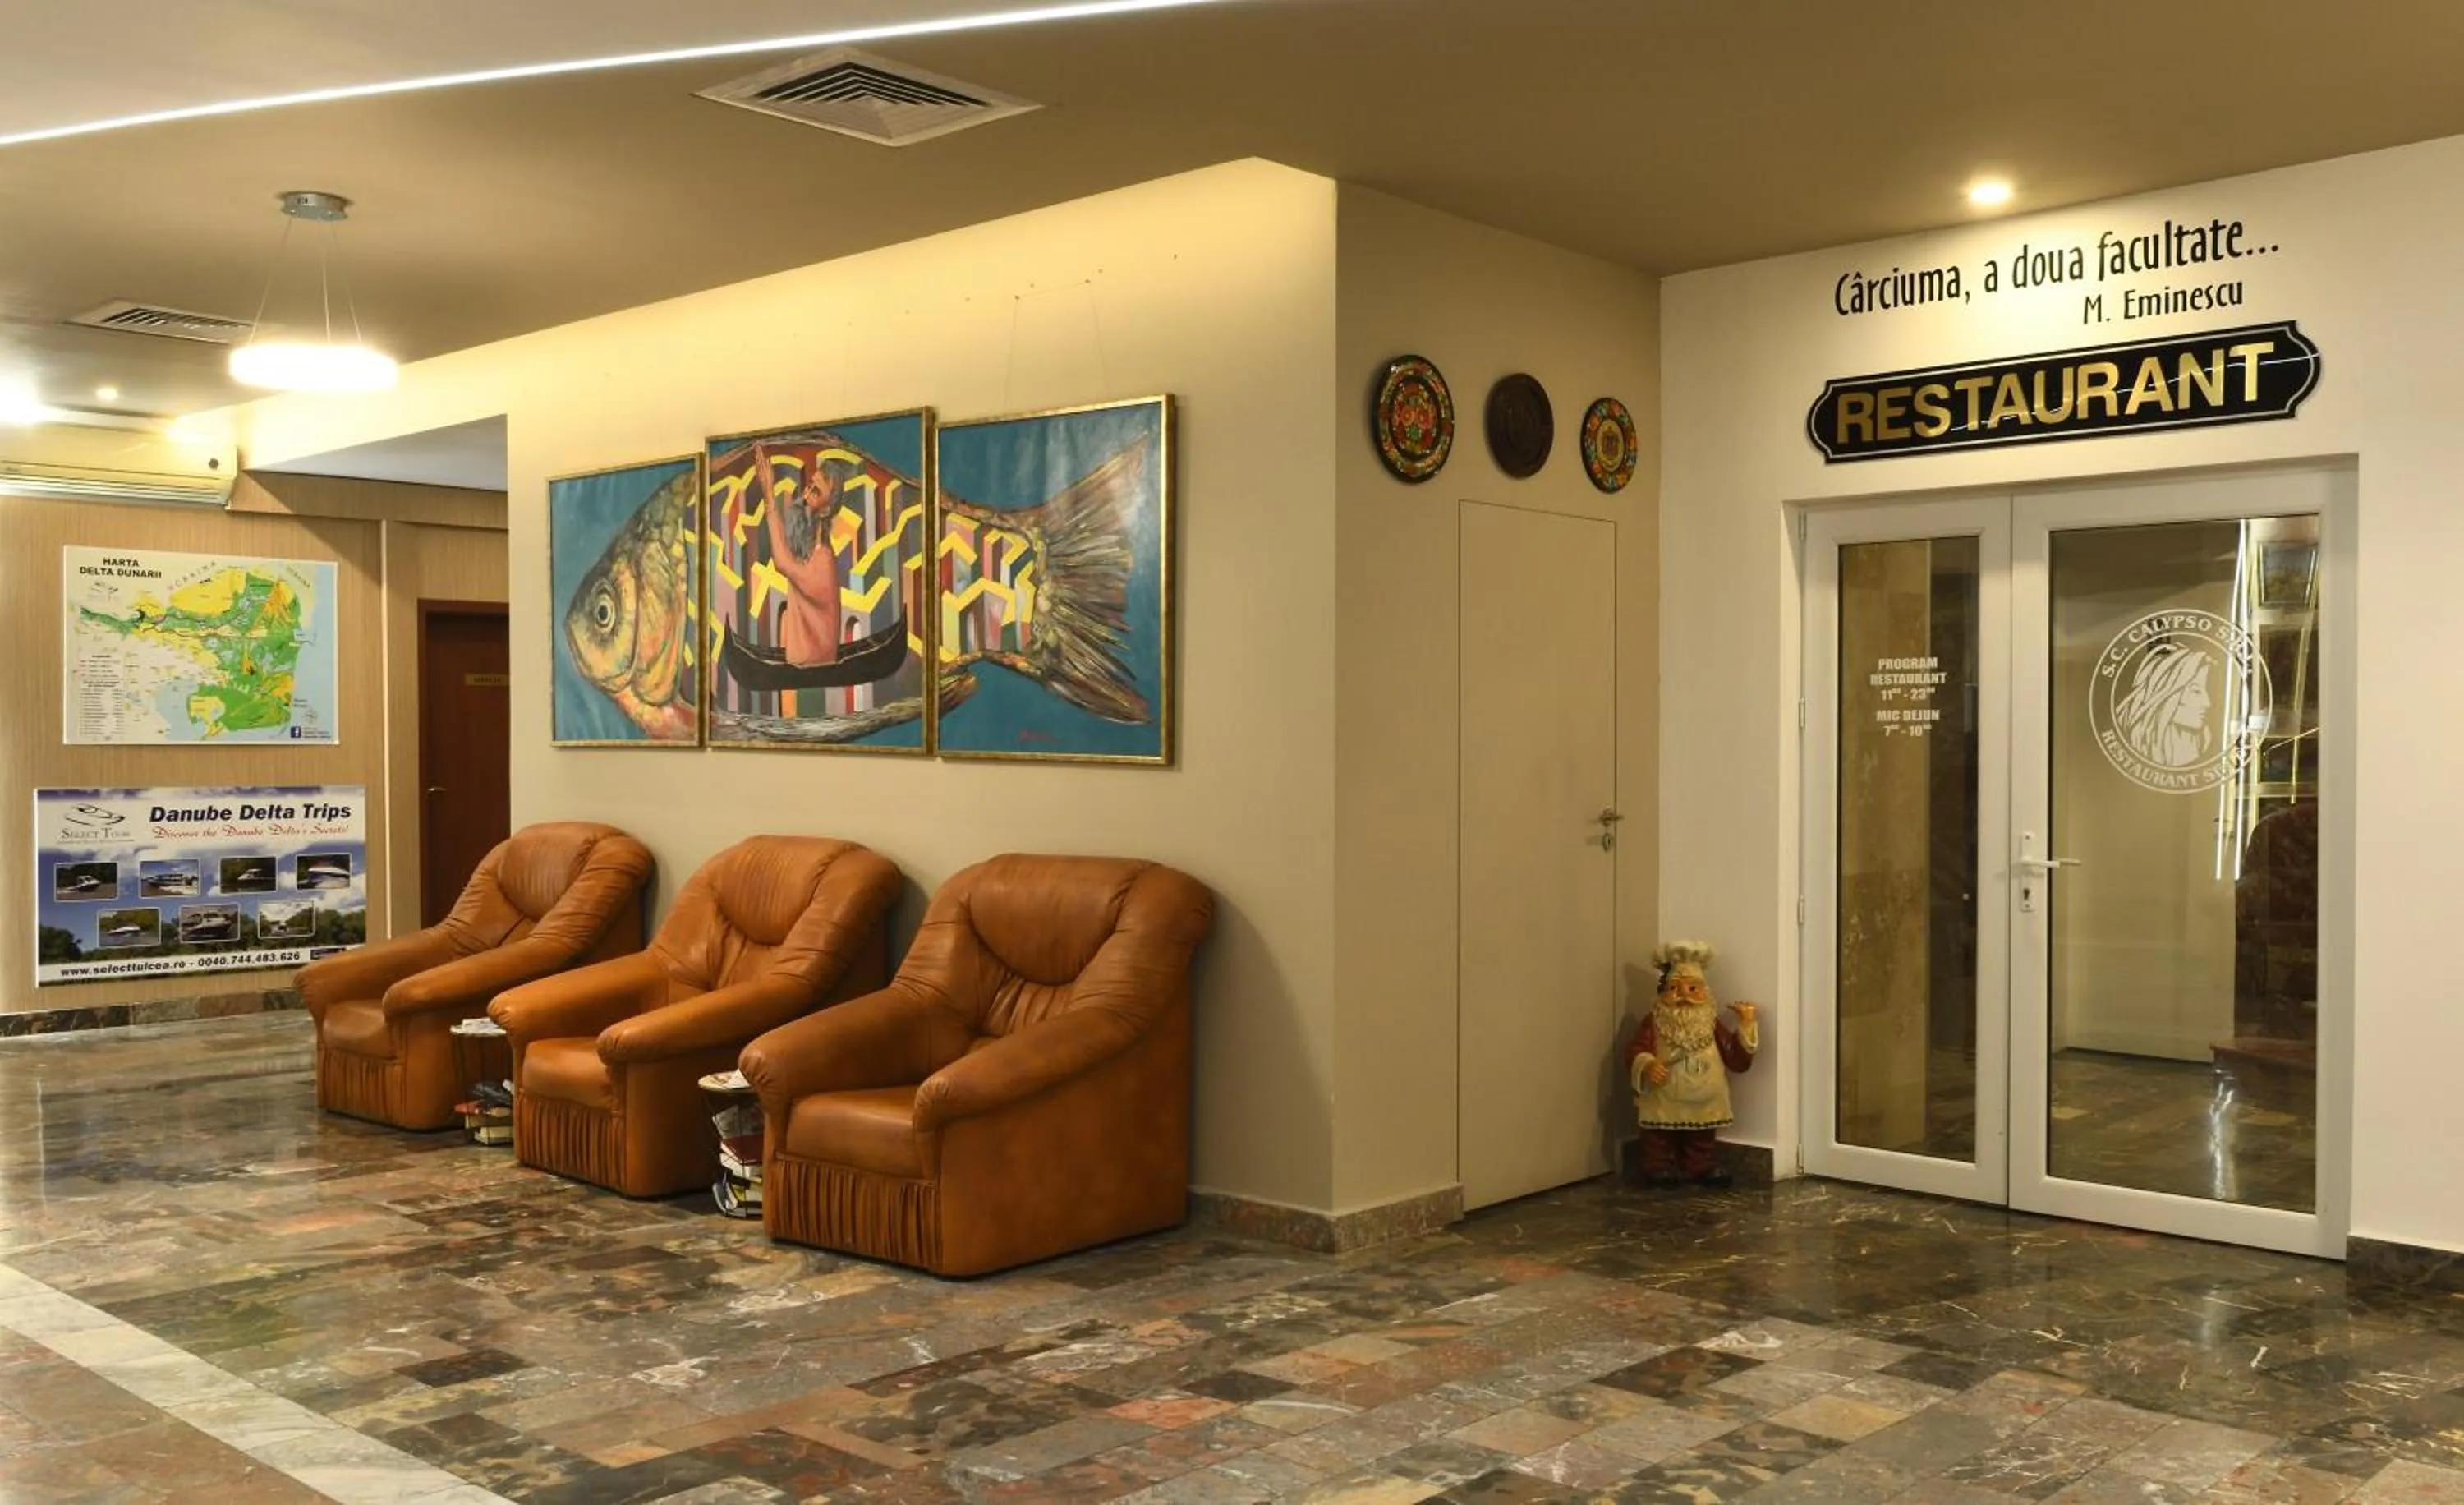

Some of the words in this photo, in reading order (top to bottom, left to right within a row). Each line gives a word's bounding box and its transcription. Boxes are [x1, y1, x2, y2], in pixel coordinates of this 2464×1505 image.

[1834, 265, 1971, 316] Cârciuma,
[1984, 260, 1999, 293] a
[2011, 245, 2085, 289] doua
[2098, 219, 2279, 282] facultate...
[2083, 293, 2111, 324] M.
[2123, 280, 2243, 320] Eminescu
[1837, 342, 2274, 445] RESTAURANT
[79, 566, 113, 576] DELTA
[103, 557, 139, 568] HARTA
[2128, 615, 2212, 642] CALYPSO
[1878, 657, 1938, 670] PROGRAM
[1870, 672, 1947, 685] RESTAURANT
[1876, 710, 1901, 721] MIC
[2102, 729, 2199, 786] RESTAURANT
[149, 805, 232, 822] Danube
[239, 804, 295, 820] Delta
[303, 803, 351, 822] Trips
